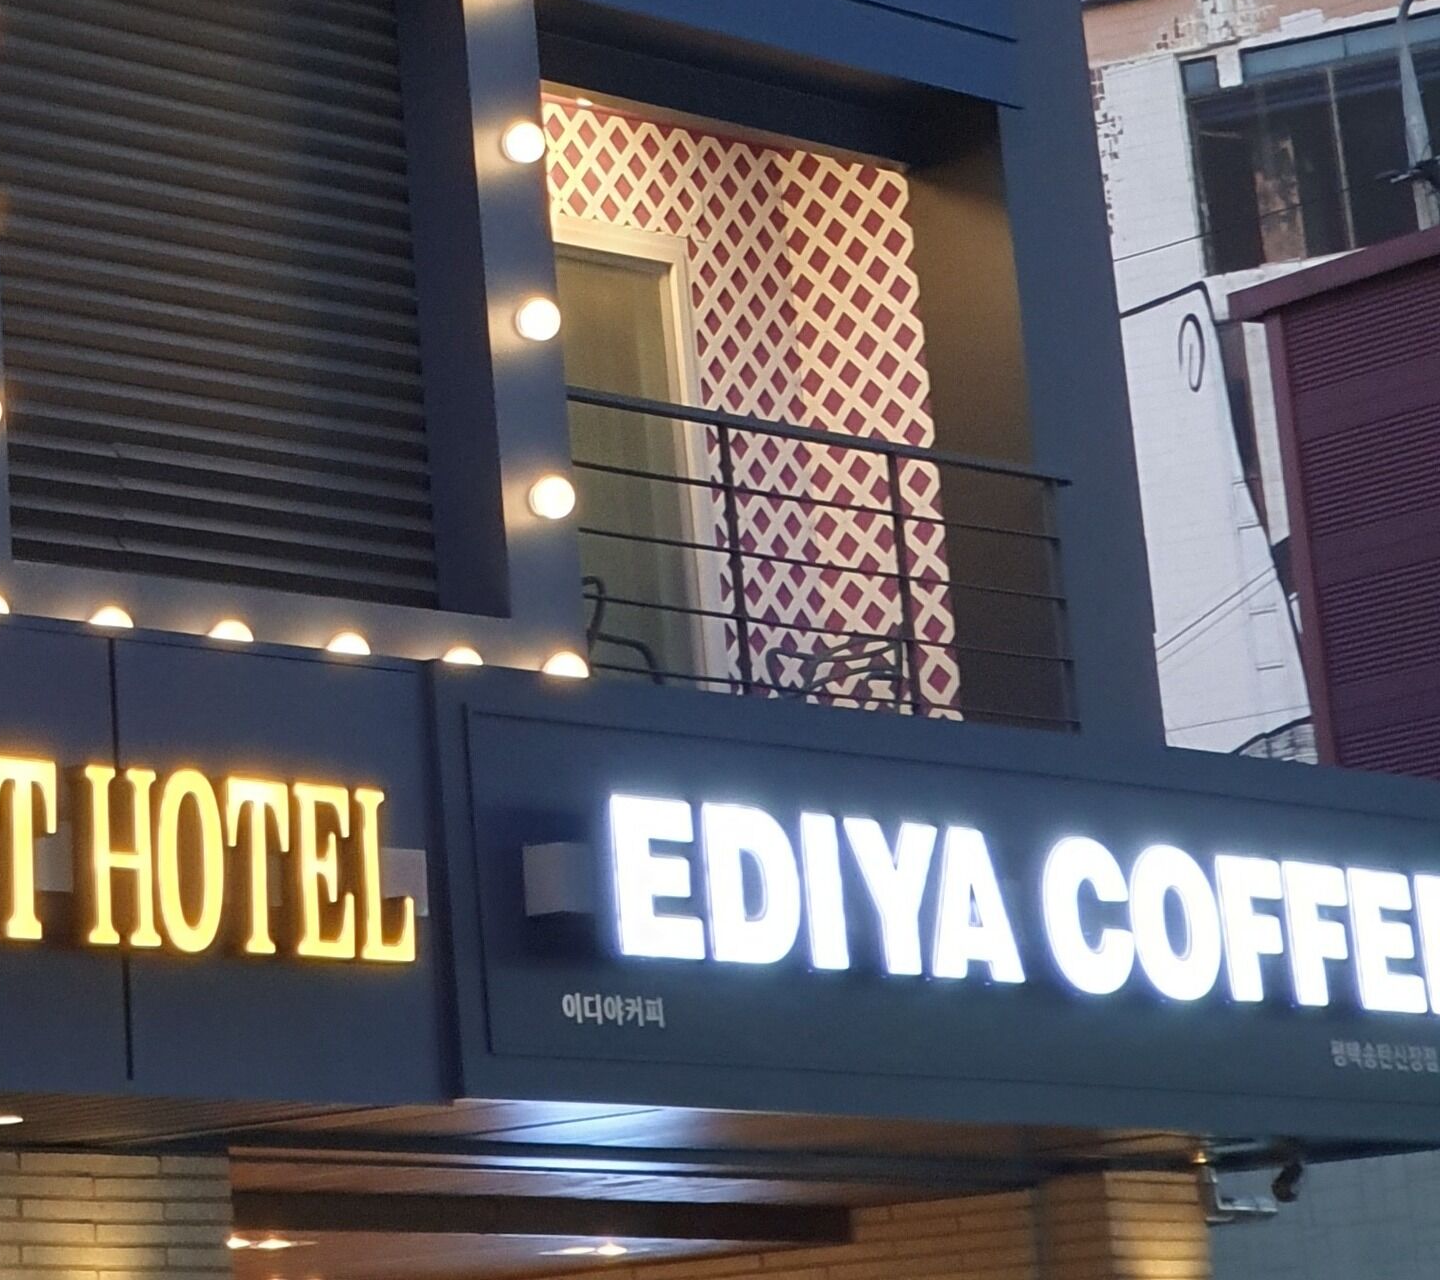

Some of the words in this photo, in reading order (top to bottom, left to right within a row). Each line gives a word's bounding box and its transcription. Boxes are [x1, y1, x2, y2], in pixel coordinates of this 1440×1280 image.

[84, 762, 418, 964] HOTEL
[607, 792, 1026, 985] EDIYA
[1041, 834, 1440, 1016] COFFE
[561, 991, 666, 1029] 이디야커피
